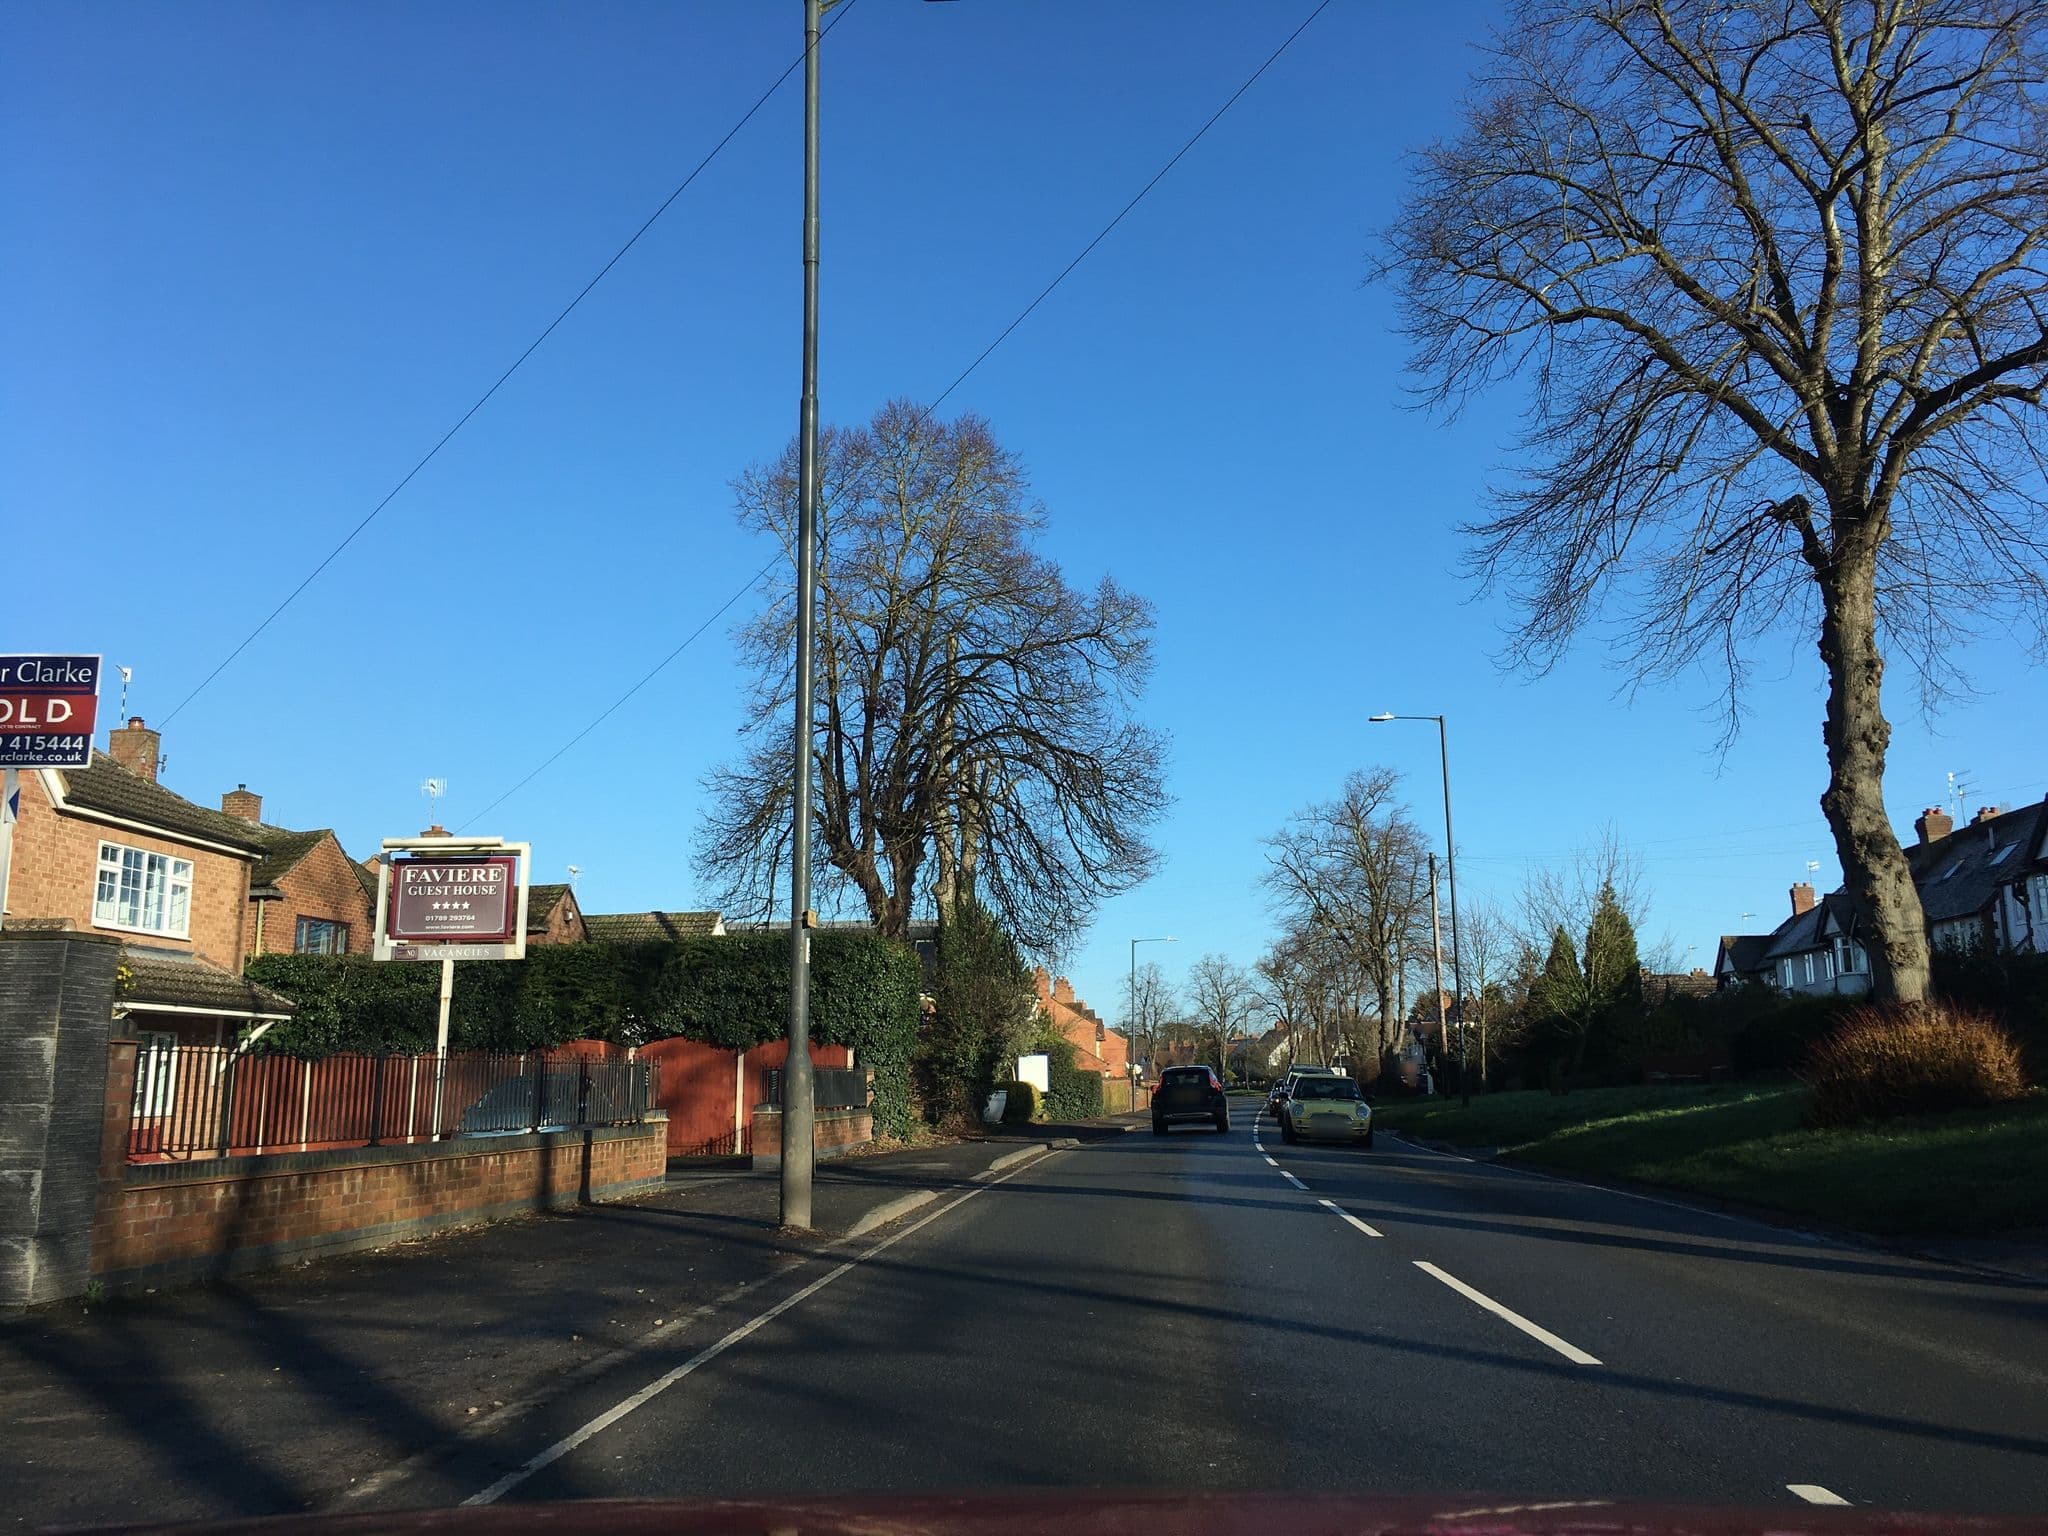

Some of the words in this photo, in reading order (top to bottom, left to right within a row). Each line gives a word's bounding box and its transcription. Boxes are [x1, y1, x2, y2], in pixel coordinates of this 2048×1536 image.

[17, 661, 92, 683] Clarke
[9, 735, 84, 751] 415444
[405, 868, 502, 883] FAVIERE
[408, 885, 450, 896] GUEST
[453, 885, 497, 895] HOUSE
[425, 914, 448, 922] 01789
[424, 948, 490, 957] VACANCIES
